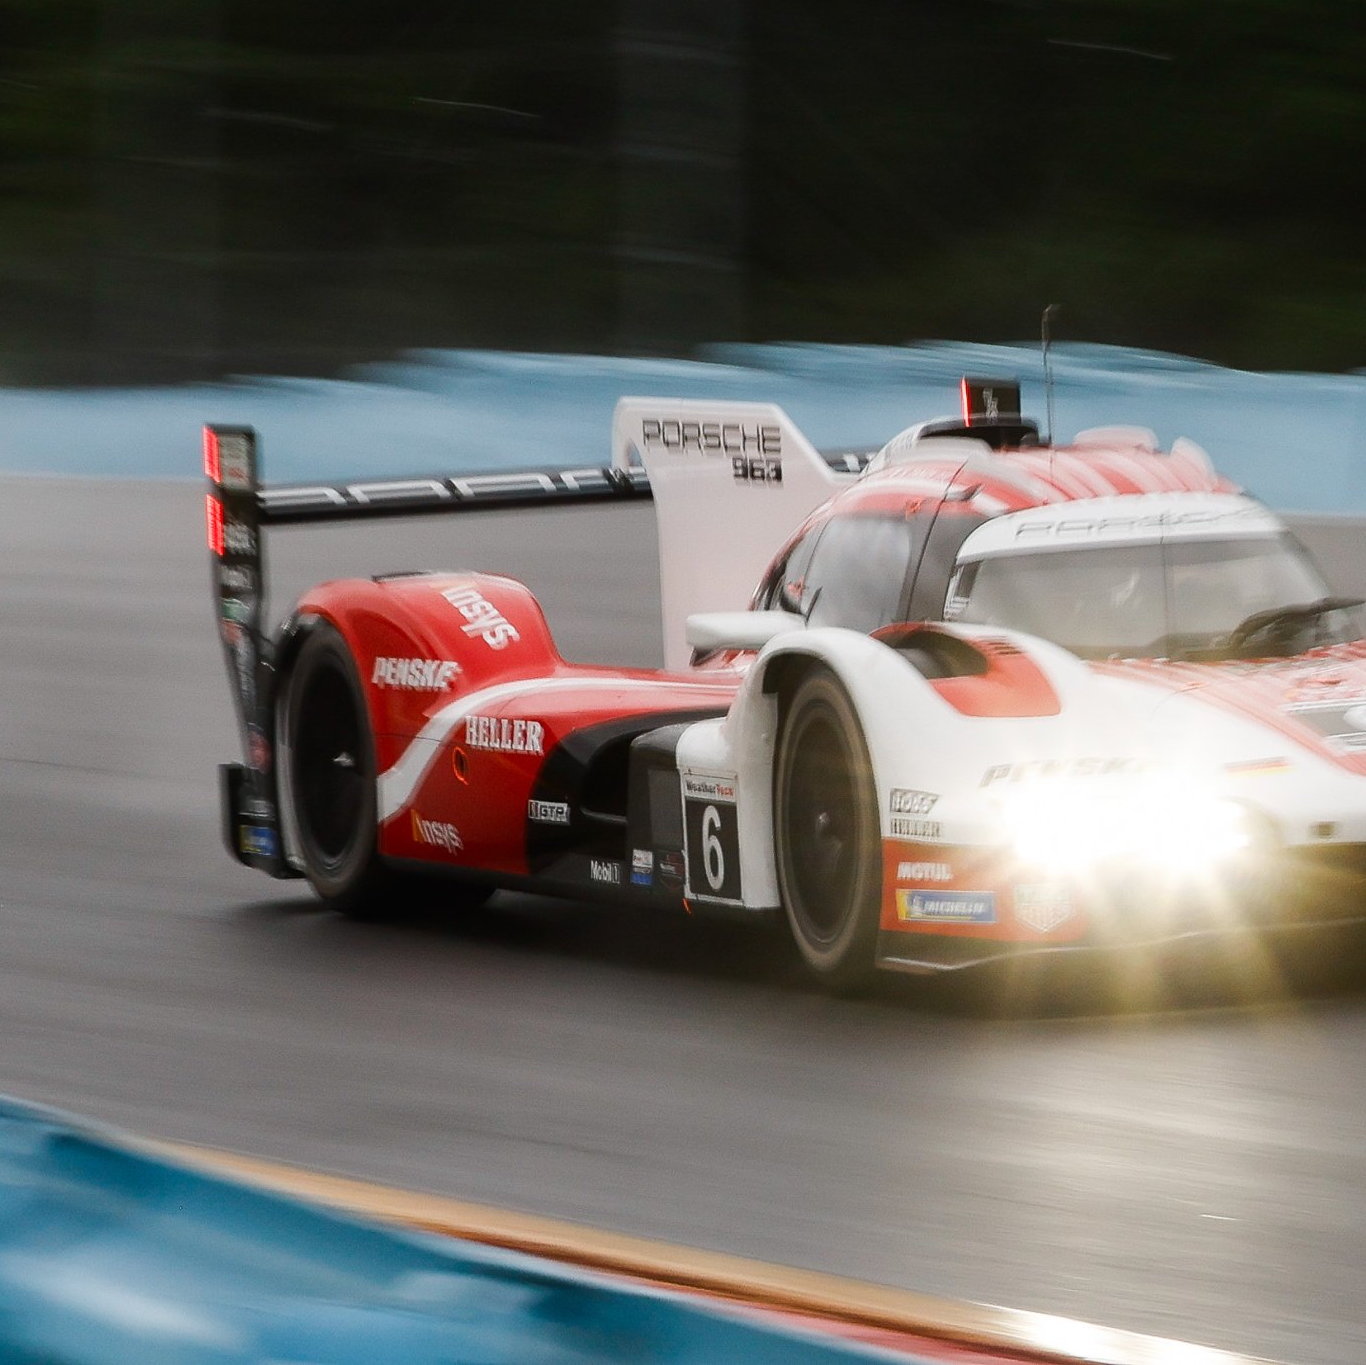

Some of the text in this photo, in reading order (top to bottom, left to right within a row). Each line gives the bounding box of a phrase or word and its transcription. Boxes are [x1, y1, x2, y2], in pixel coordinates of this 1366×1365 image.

[643, 420, 782, 456] PORSCHE
[372, 657, 463, 690] PENSKE
[466, 715, 545, 754] HELLER
[539, 804, 565, 818] GTP
[702, 804, 726, 891] 6
[590, 860, 612, 882] Mobil
